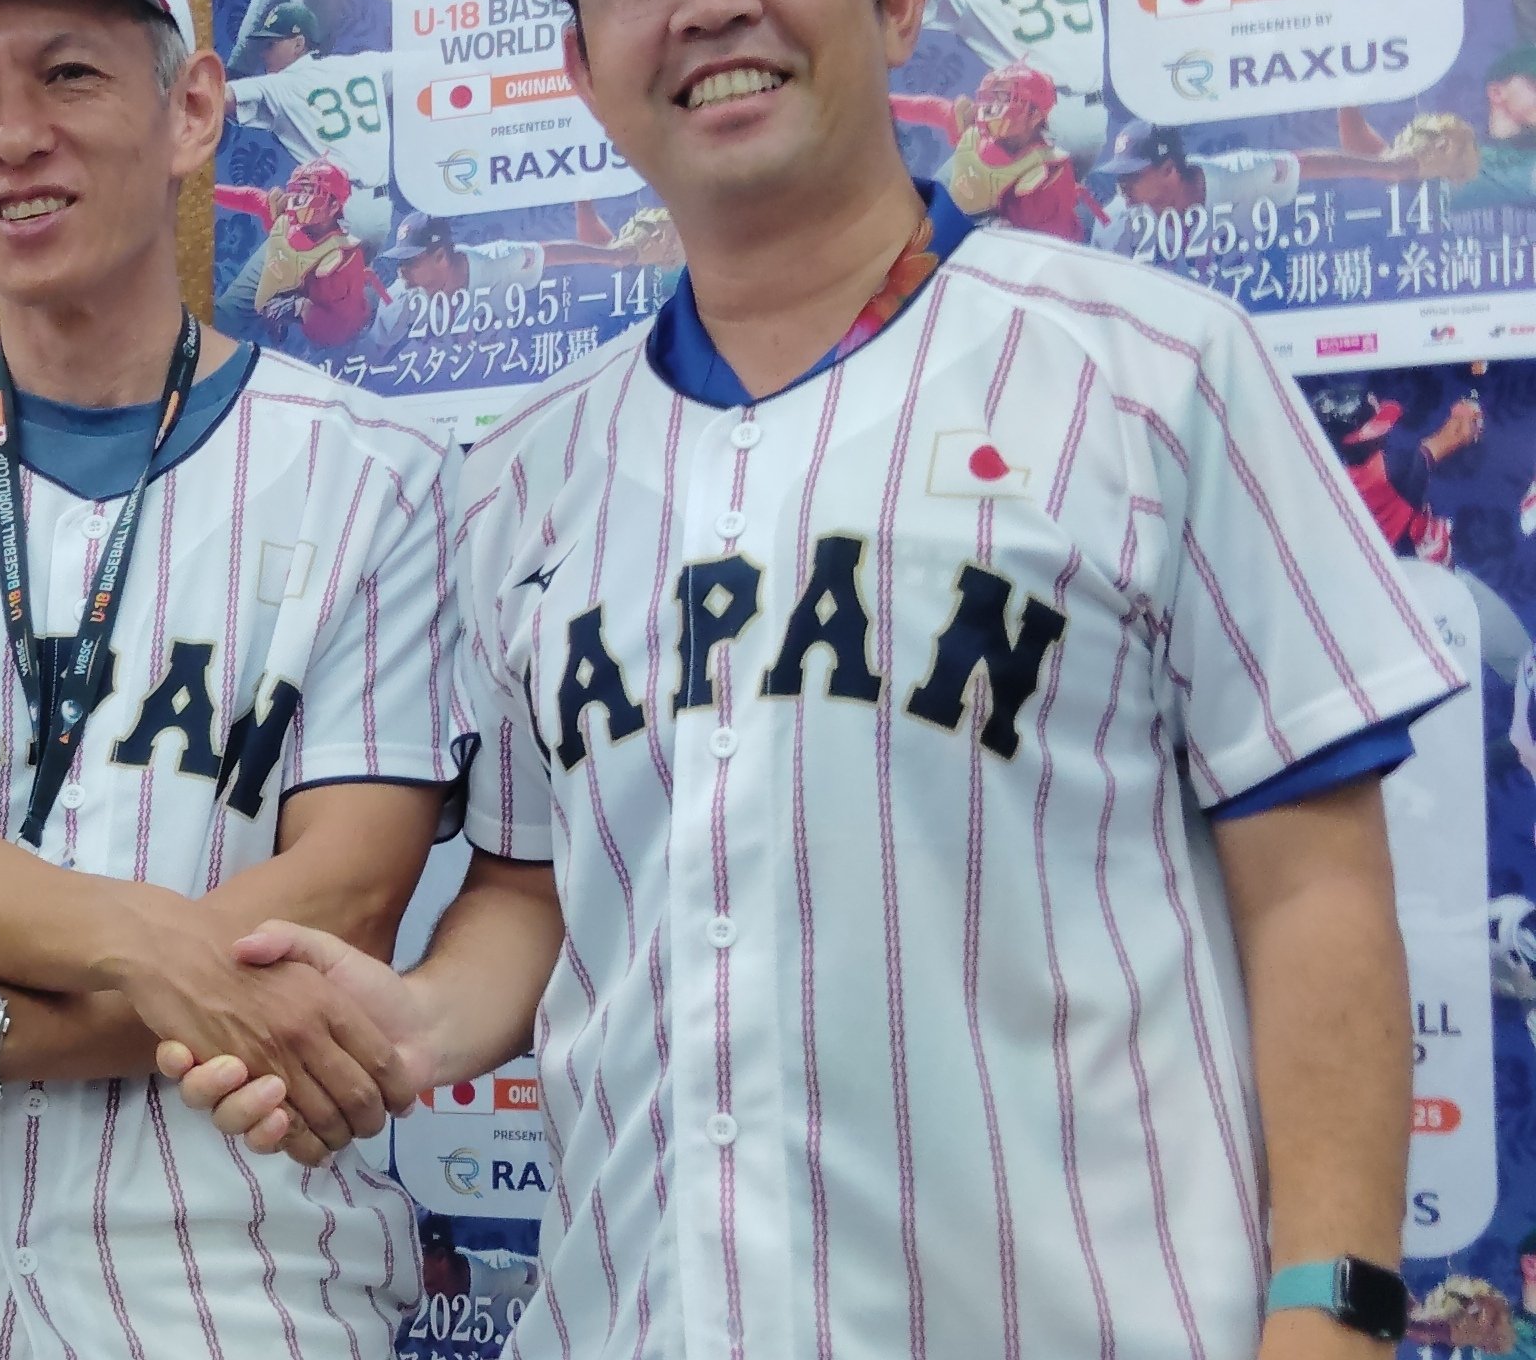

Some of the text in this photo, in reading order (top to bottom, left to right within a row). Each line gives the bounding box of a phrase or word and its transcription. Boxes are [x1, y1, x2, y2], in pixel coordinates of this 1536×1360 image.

[413, 1, 480, 36] U-18
[1230, 13, 1333, 36] PRESENTED BY
[439, 23, 556, 65] WORLD
[1229, 35, 1410, 89] RAXUS
[505, 74, 573, 99] OKINAW
[306, 75, 382, 142] 39
[490, 116, 573, 138] PRESENTED BY
[1132, 190, 1320, 263] 2025.9.5
[407, 278, 559, 339] 2025.9.5
[2, 524, 22, 590] BASEBALL
[99, 525, 131, 591] BASEBALL
[8, 589, 23, 622] U-18
[90, 591, 112, 624] U-18
[15, 638, 29, 677] WBSC
[74, 638, 94, 676] WBSC
[524, 534, 1068, 780] APAN
[493, 1129, 547, 1143] PRESENT
